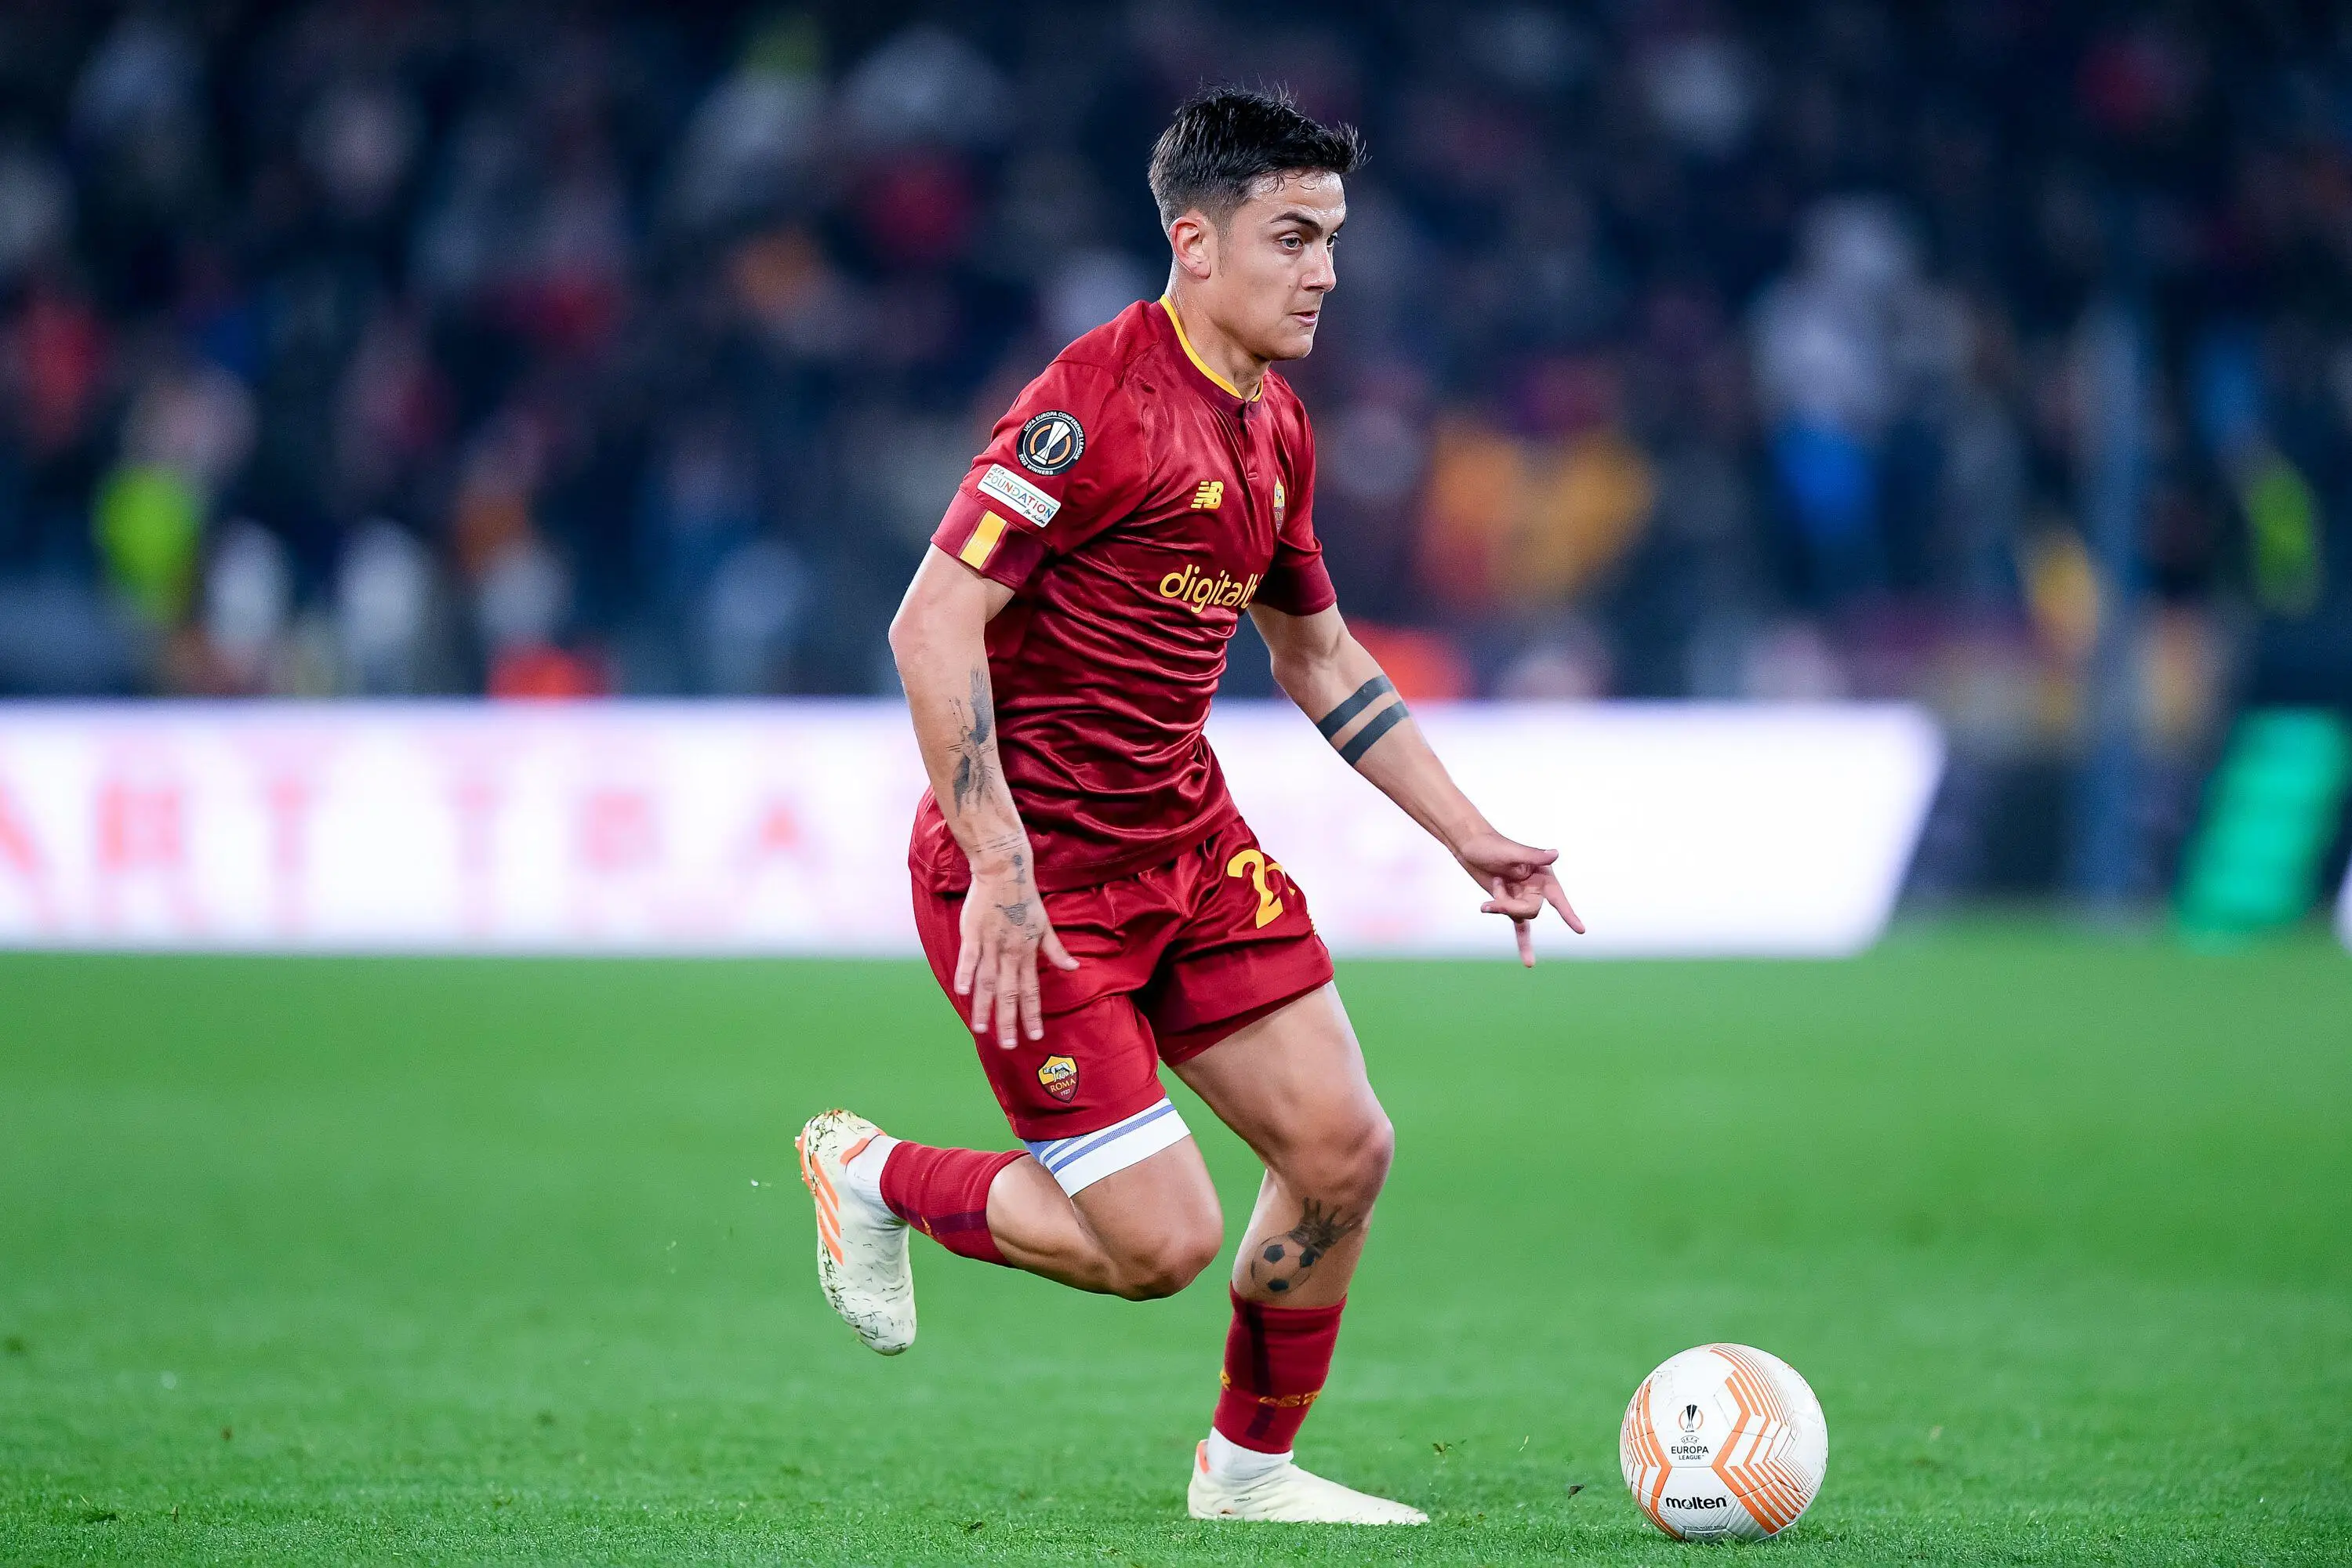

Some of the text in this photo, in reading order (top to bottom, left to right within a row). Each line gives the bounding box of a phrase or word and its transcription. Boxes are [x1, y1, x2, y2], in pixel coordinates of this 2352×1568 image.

[1024, 412, 1084, 460] UEFA EUROPA CONFERENCE LEAGUE
[1018, 453, 1053, 474] 2022 WINNERS
[1160, 564, 1260, 614] digitalb
[1227, 848, 1296, 930] 2
[1051, 1078, 1076, 1092] ROMA
[1666, 1495, 1727, 1510] molten
